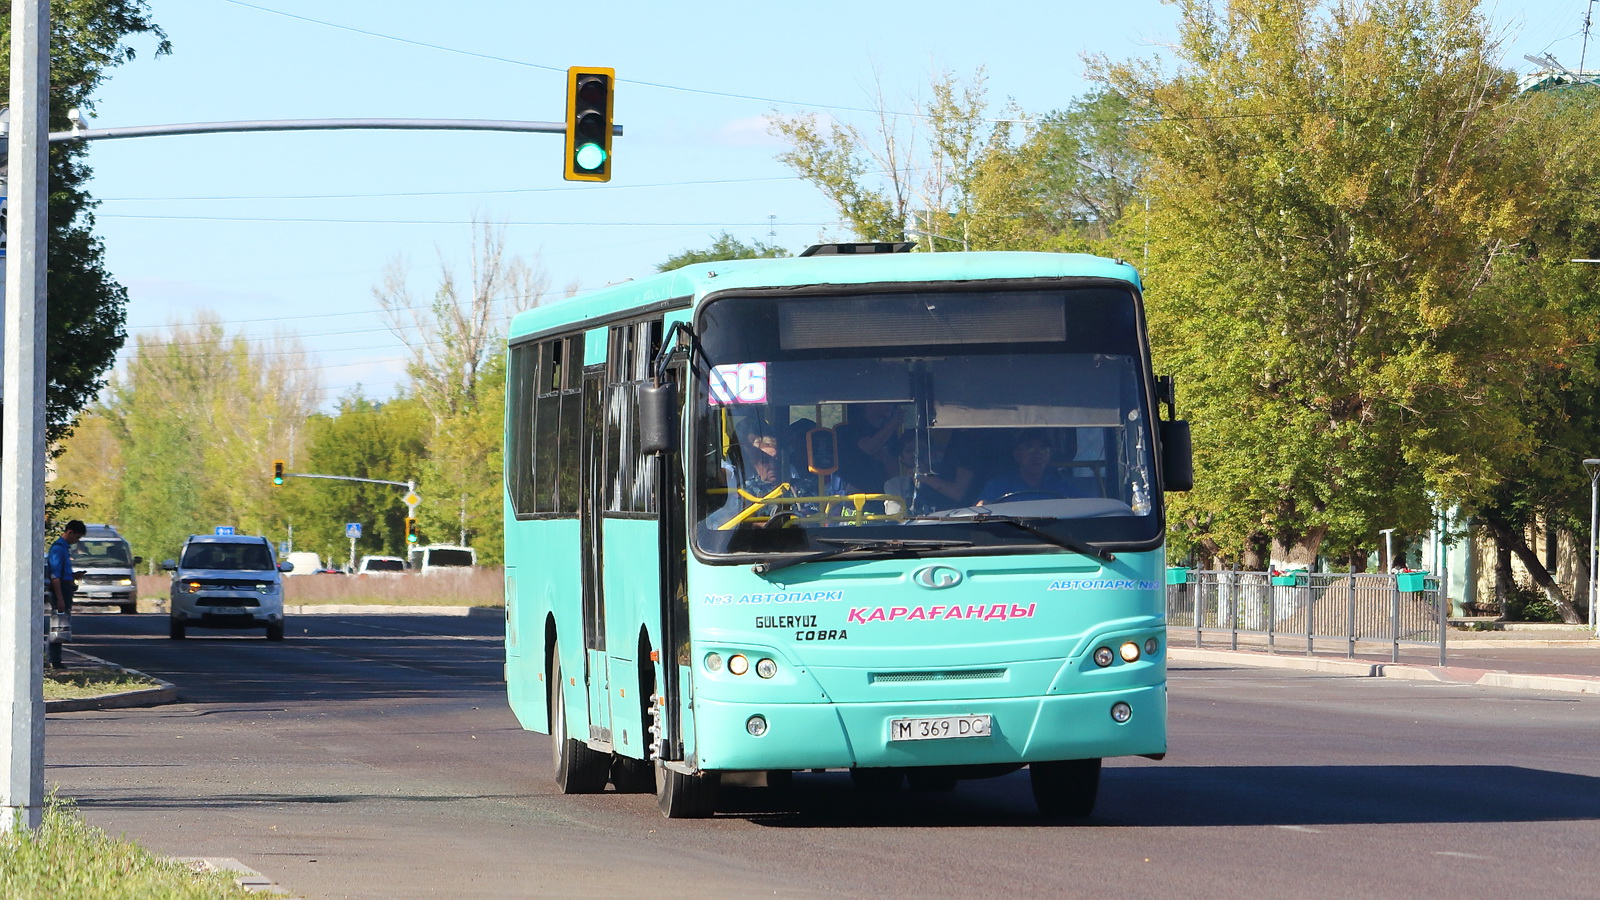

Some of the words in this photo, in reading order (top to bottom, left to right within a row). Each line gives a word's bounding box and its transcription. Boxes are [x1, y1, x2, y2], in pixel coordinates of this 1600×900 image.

[710, 363, 766, 402] 56
[1048, 580, 1135, 590] АВТОПАРК
[847, 604, 1036, 625] ҚАРАҒАНДЫ
[795, 630, 848, 641] COBRA
[899, 723, 912, 738] M
[920, 721, 950, 737] 369
[958, 719, 984, 735] DC
